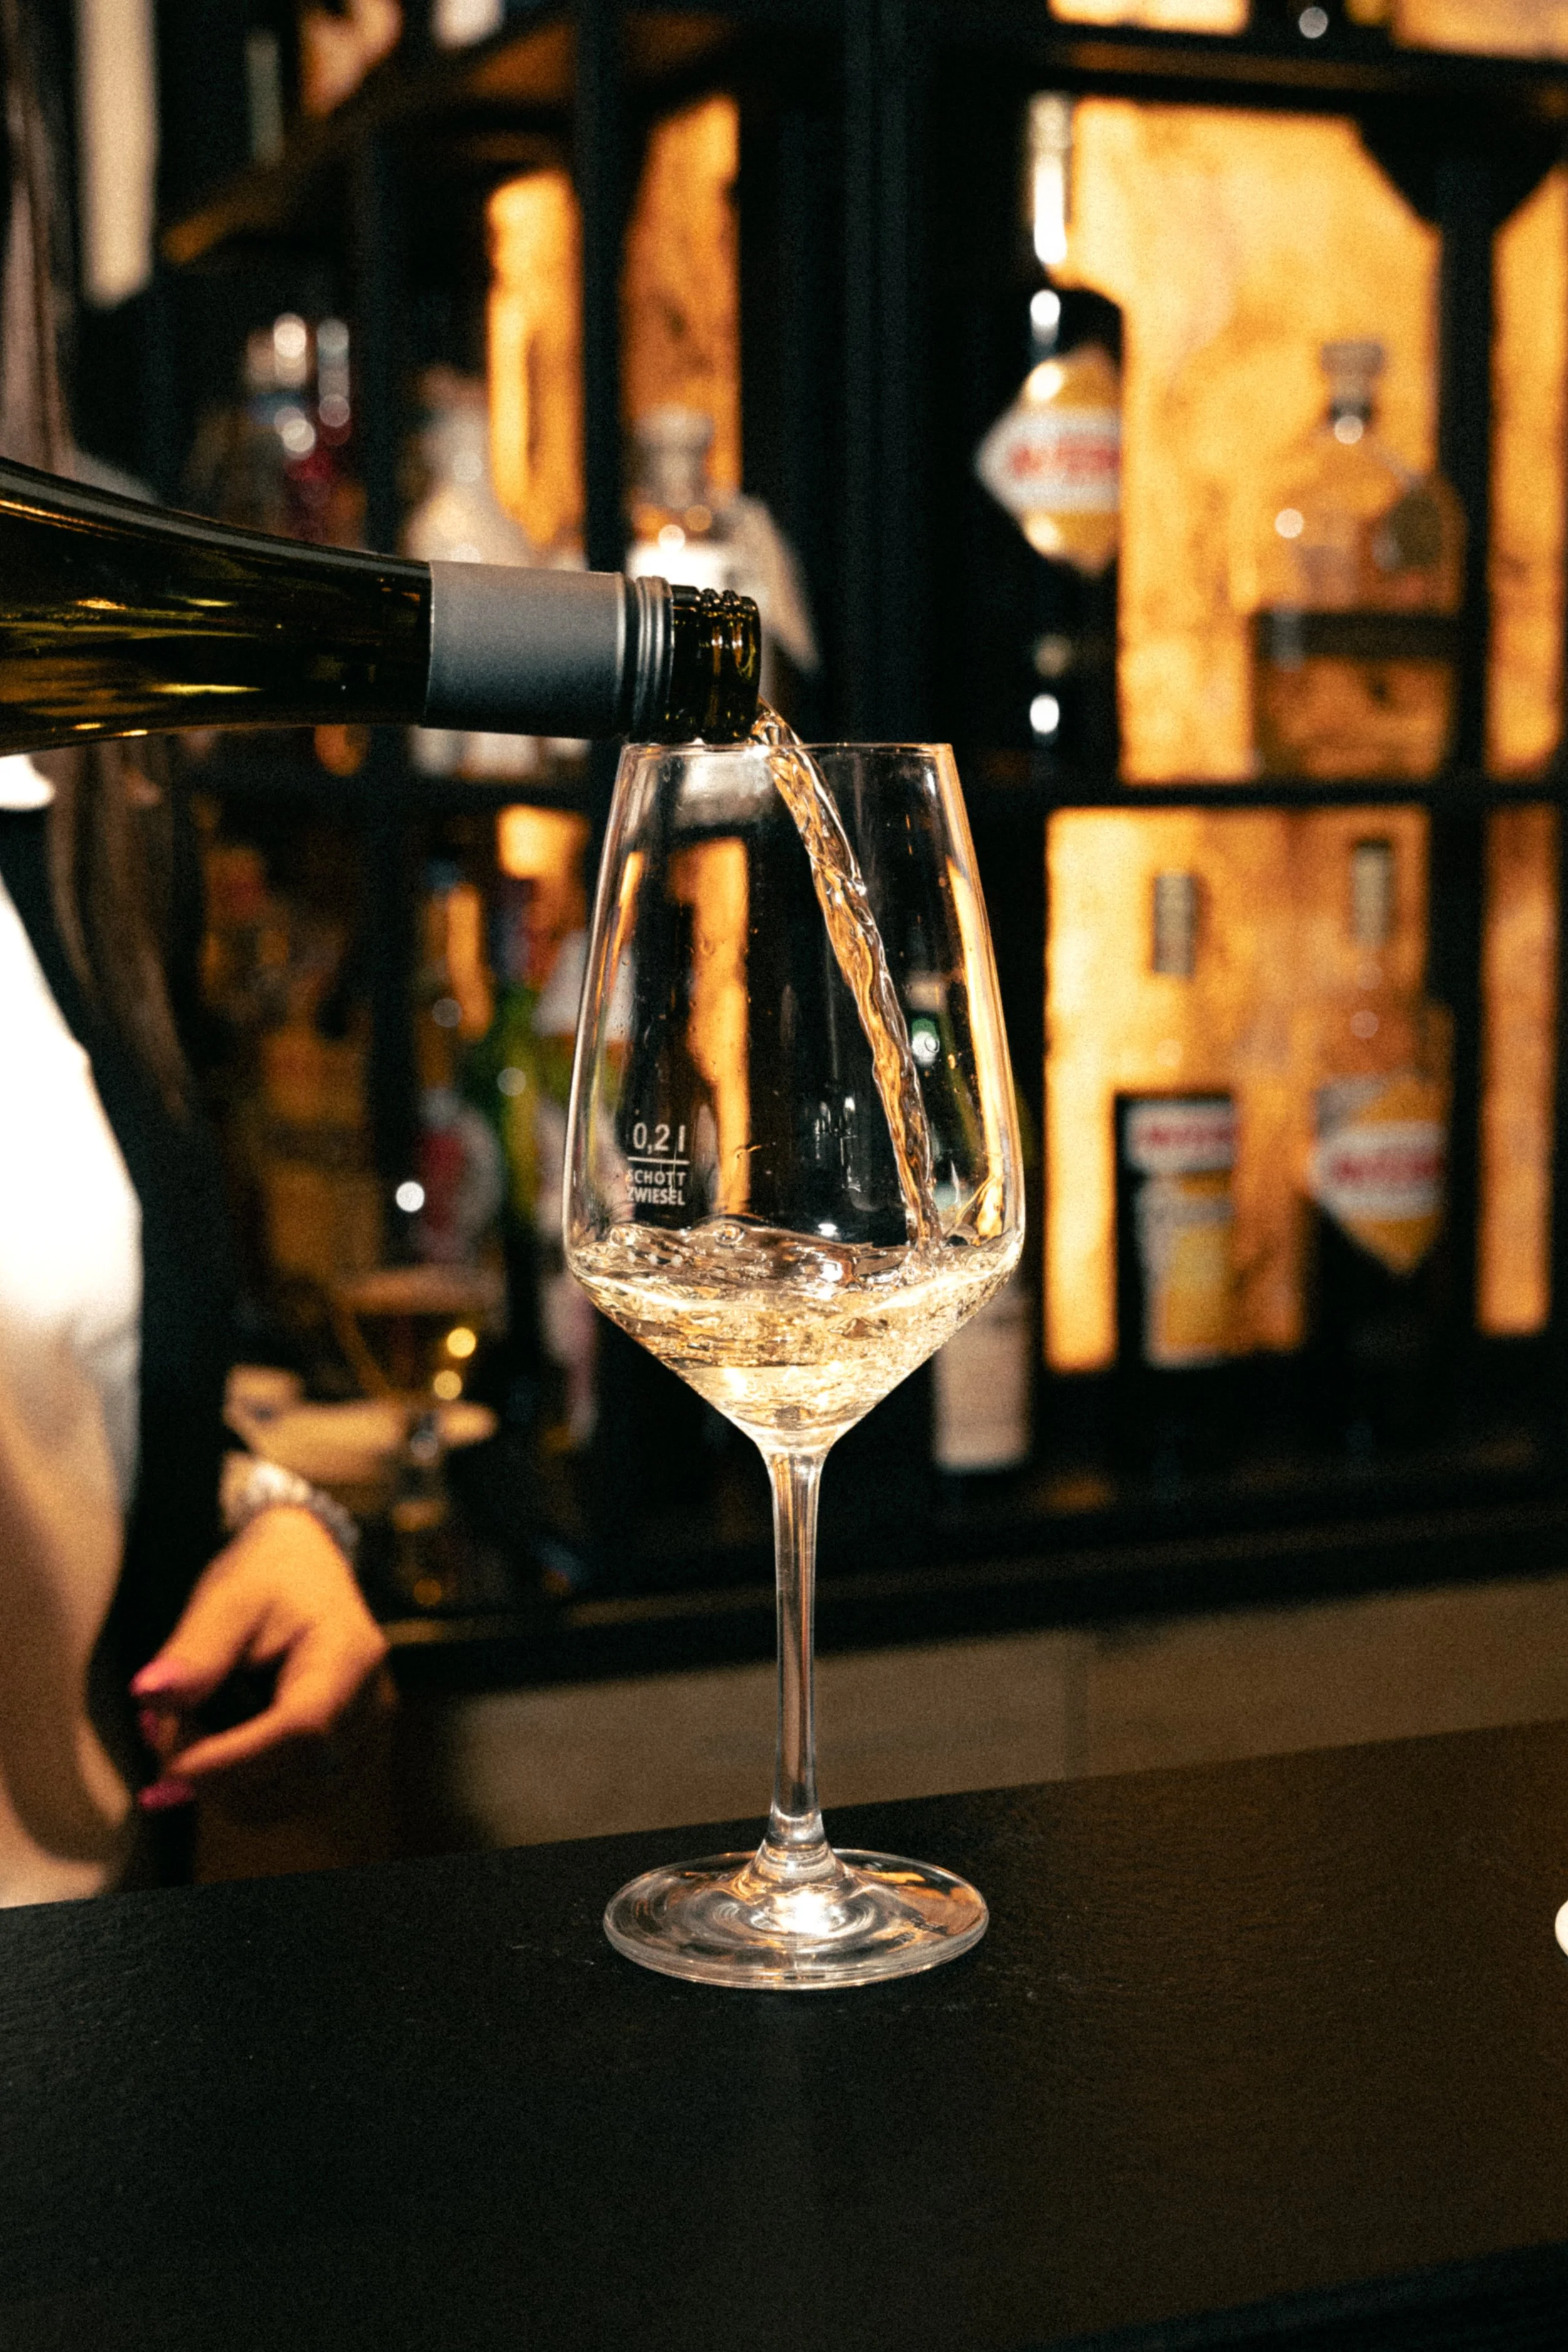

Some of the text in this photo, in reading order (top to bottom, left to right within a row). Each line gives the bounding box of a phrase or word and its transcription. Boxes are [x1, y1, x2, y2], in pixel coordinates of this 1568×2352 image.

[633, 1122, 670, 1155] 0,2
[626, 1169, 686, 1186] SCHOTT
[627, 1186, 686, 1205] ZWIESEL
